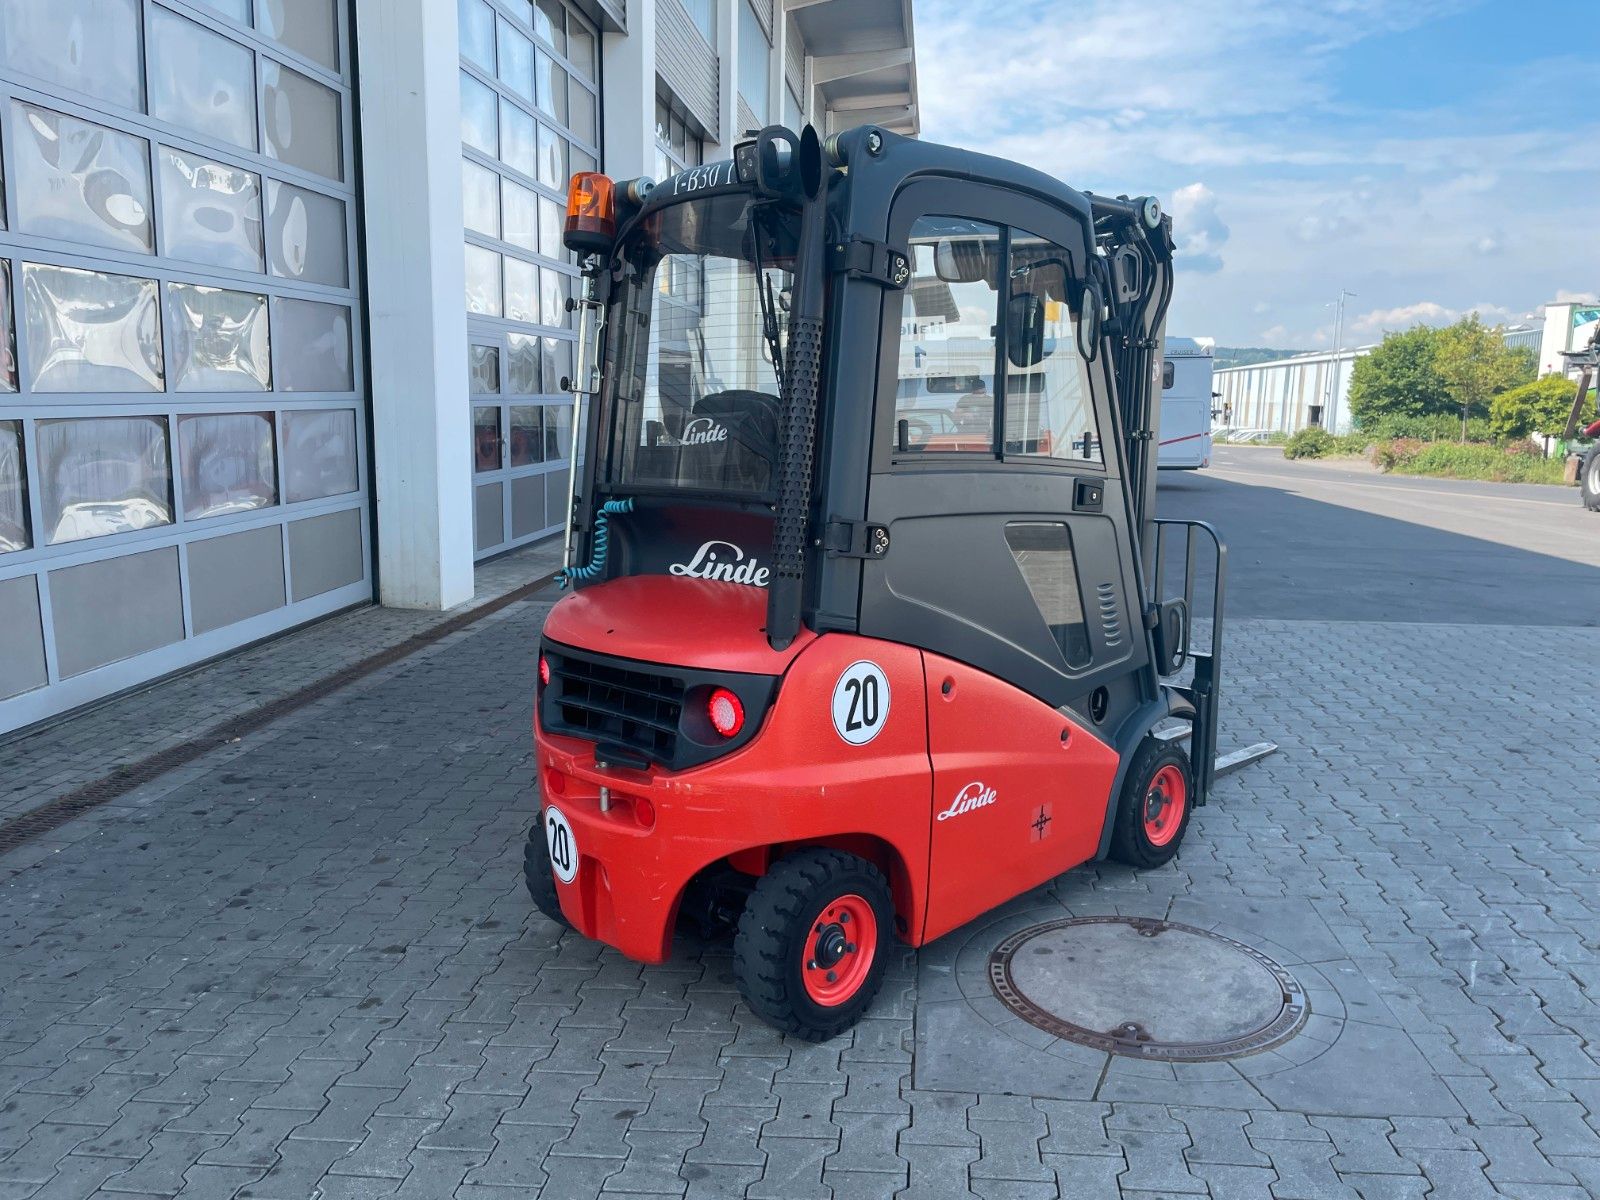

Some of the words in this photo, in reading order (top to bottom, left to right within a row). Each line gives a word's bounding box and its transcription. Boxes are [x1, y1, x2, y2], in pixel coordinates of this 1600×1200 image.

[678, 417, 728, 446] Linde
[669, 540, 770, 587] Linde
[844, 674, 879, 732] 20
[937, 781, 997, 822] Linde
[549, 817, 570, 872] 20
